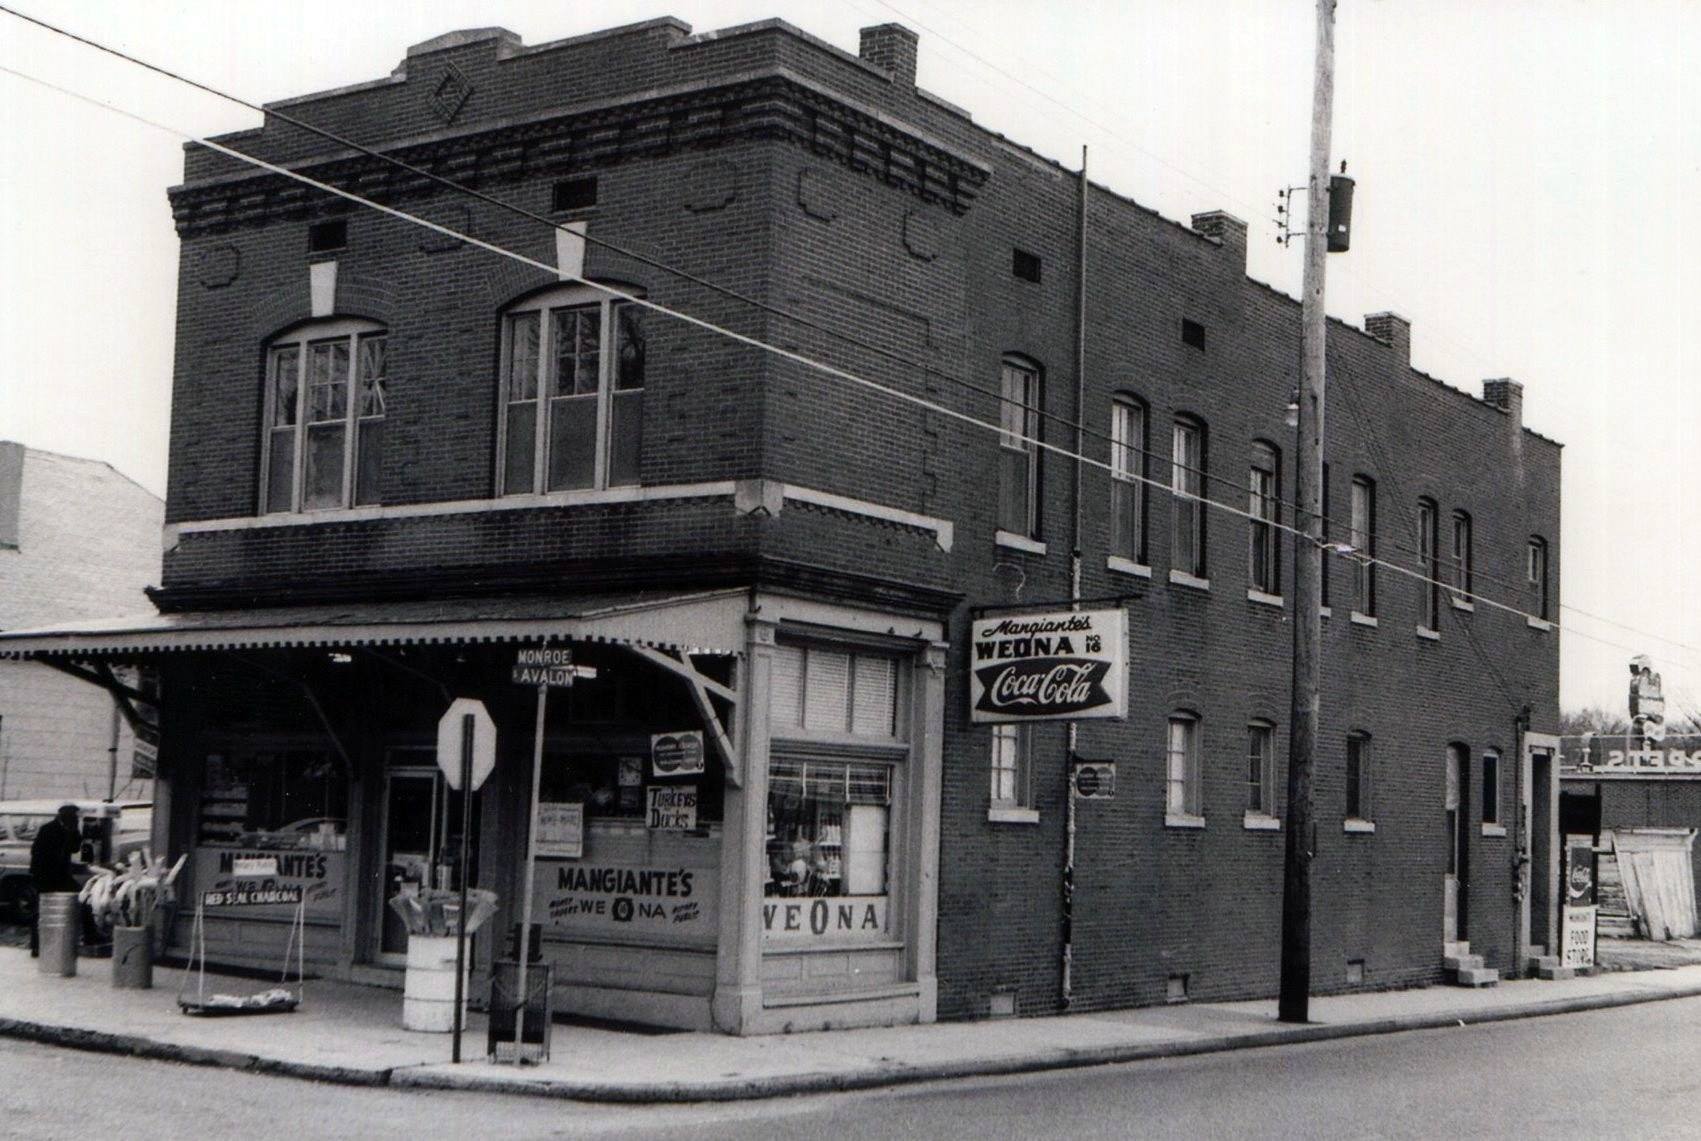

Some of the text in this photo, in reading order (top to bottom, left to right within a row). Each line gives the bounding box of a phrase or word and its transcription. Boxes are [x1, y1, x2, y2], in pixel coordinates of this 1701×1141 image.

[981, 615, 1093, 638] Mangiante's
[517, 648, 571, 664] MONROE
[520, 668, 574, 687] AVALON
[557, 866, 694, 898] MANGIANTE'S
